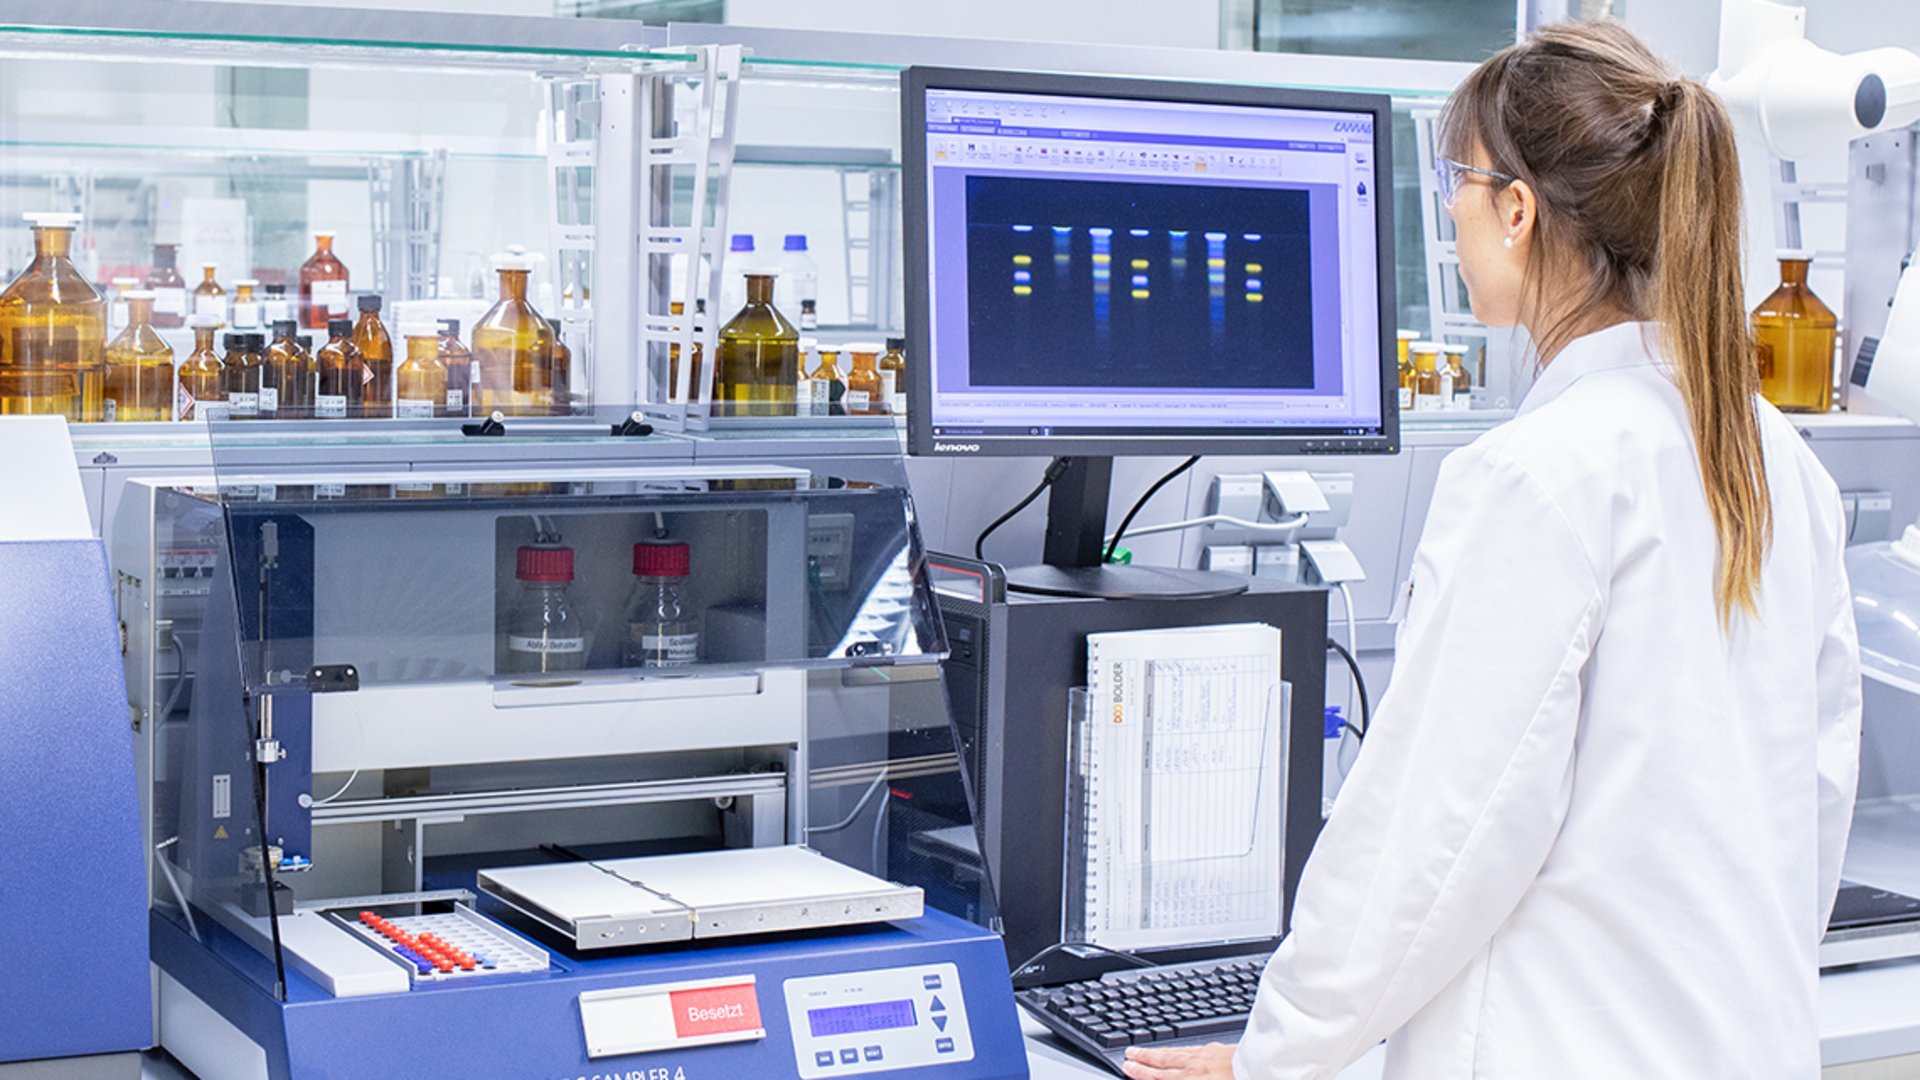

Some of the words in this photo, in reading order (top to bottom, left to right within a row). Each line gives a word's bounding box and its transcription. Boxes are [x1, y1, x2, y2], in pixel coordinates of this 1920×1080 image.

[934, 441, 980, 453] lenovo
[1112, 661, 1124, 703] BOLDER
[688, 1002, 744, 1023] Besetzt
[674, 1065, 687, 1080] 4
